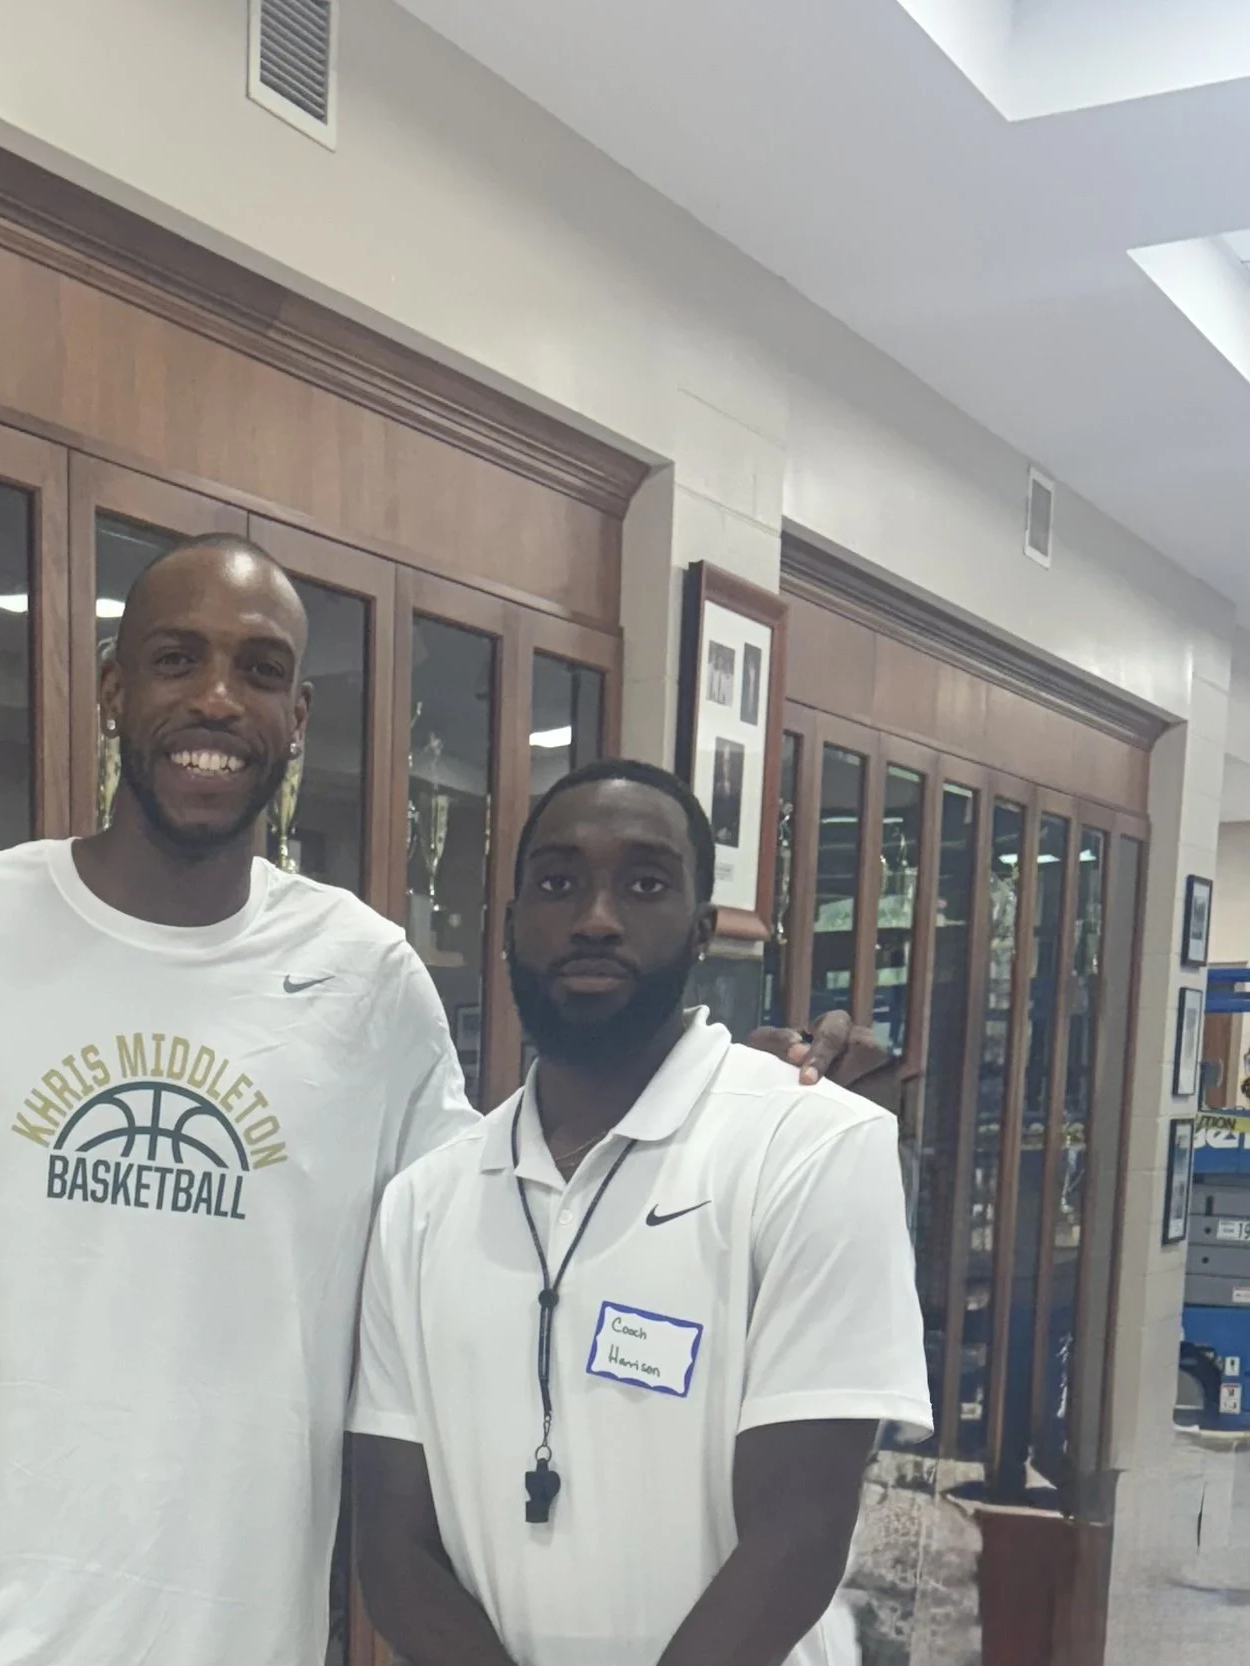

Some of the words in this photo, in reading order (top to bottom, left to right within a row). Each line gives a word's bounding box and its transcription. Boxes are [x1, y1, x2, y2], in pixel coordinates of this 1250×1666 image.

[11, 1044, 111, 1148] KHRIS
[116, 1032, 288, 1170] MIDDLETON
[46, 1154, 246, 1220] BASKETBALL
[612, 1316, 647, 1340] Coach
[608, 1344, 661, 1378] Harrison
